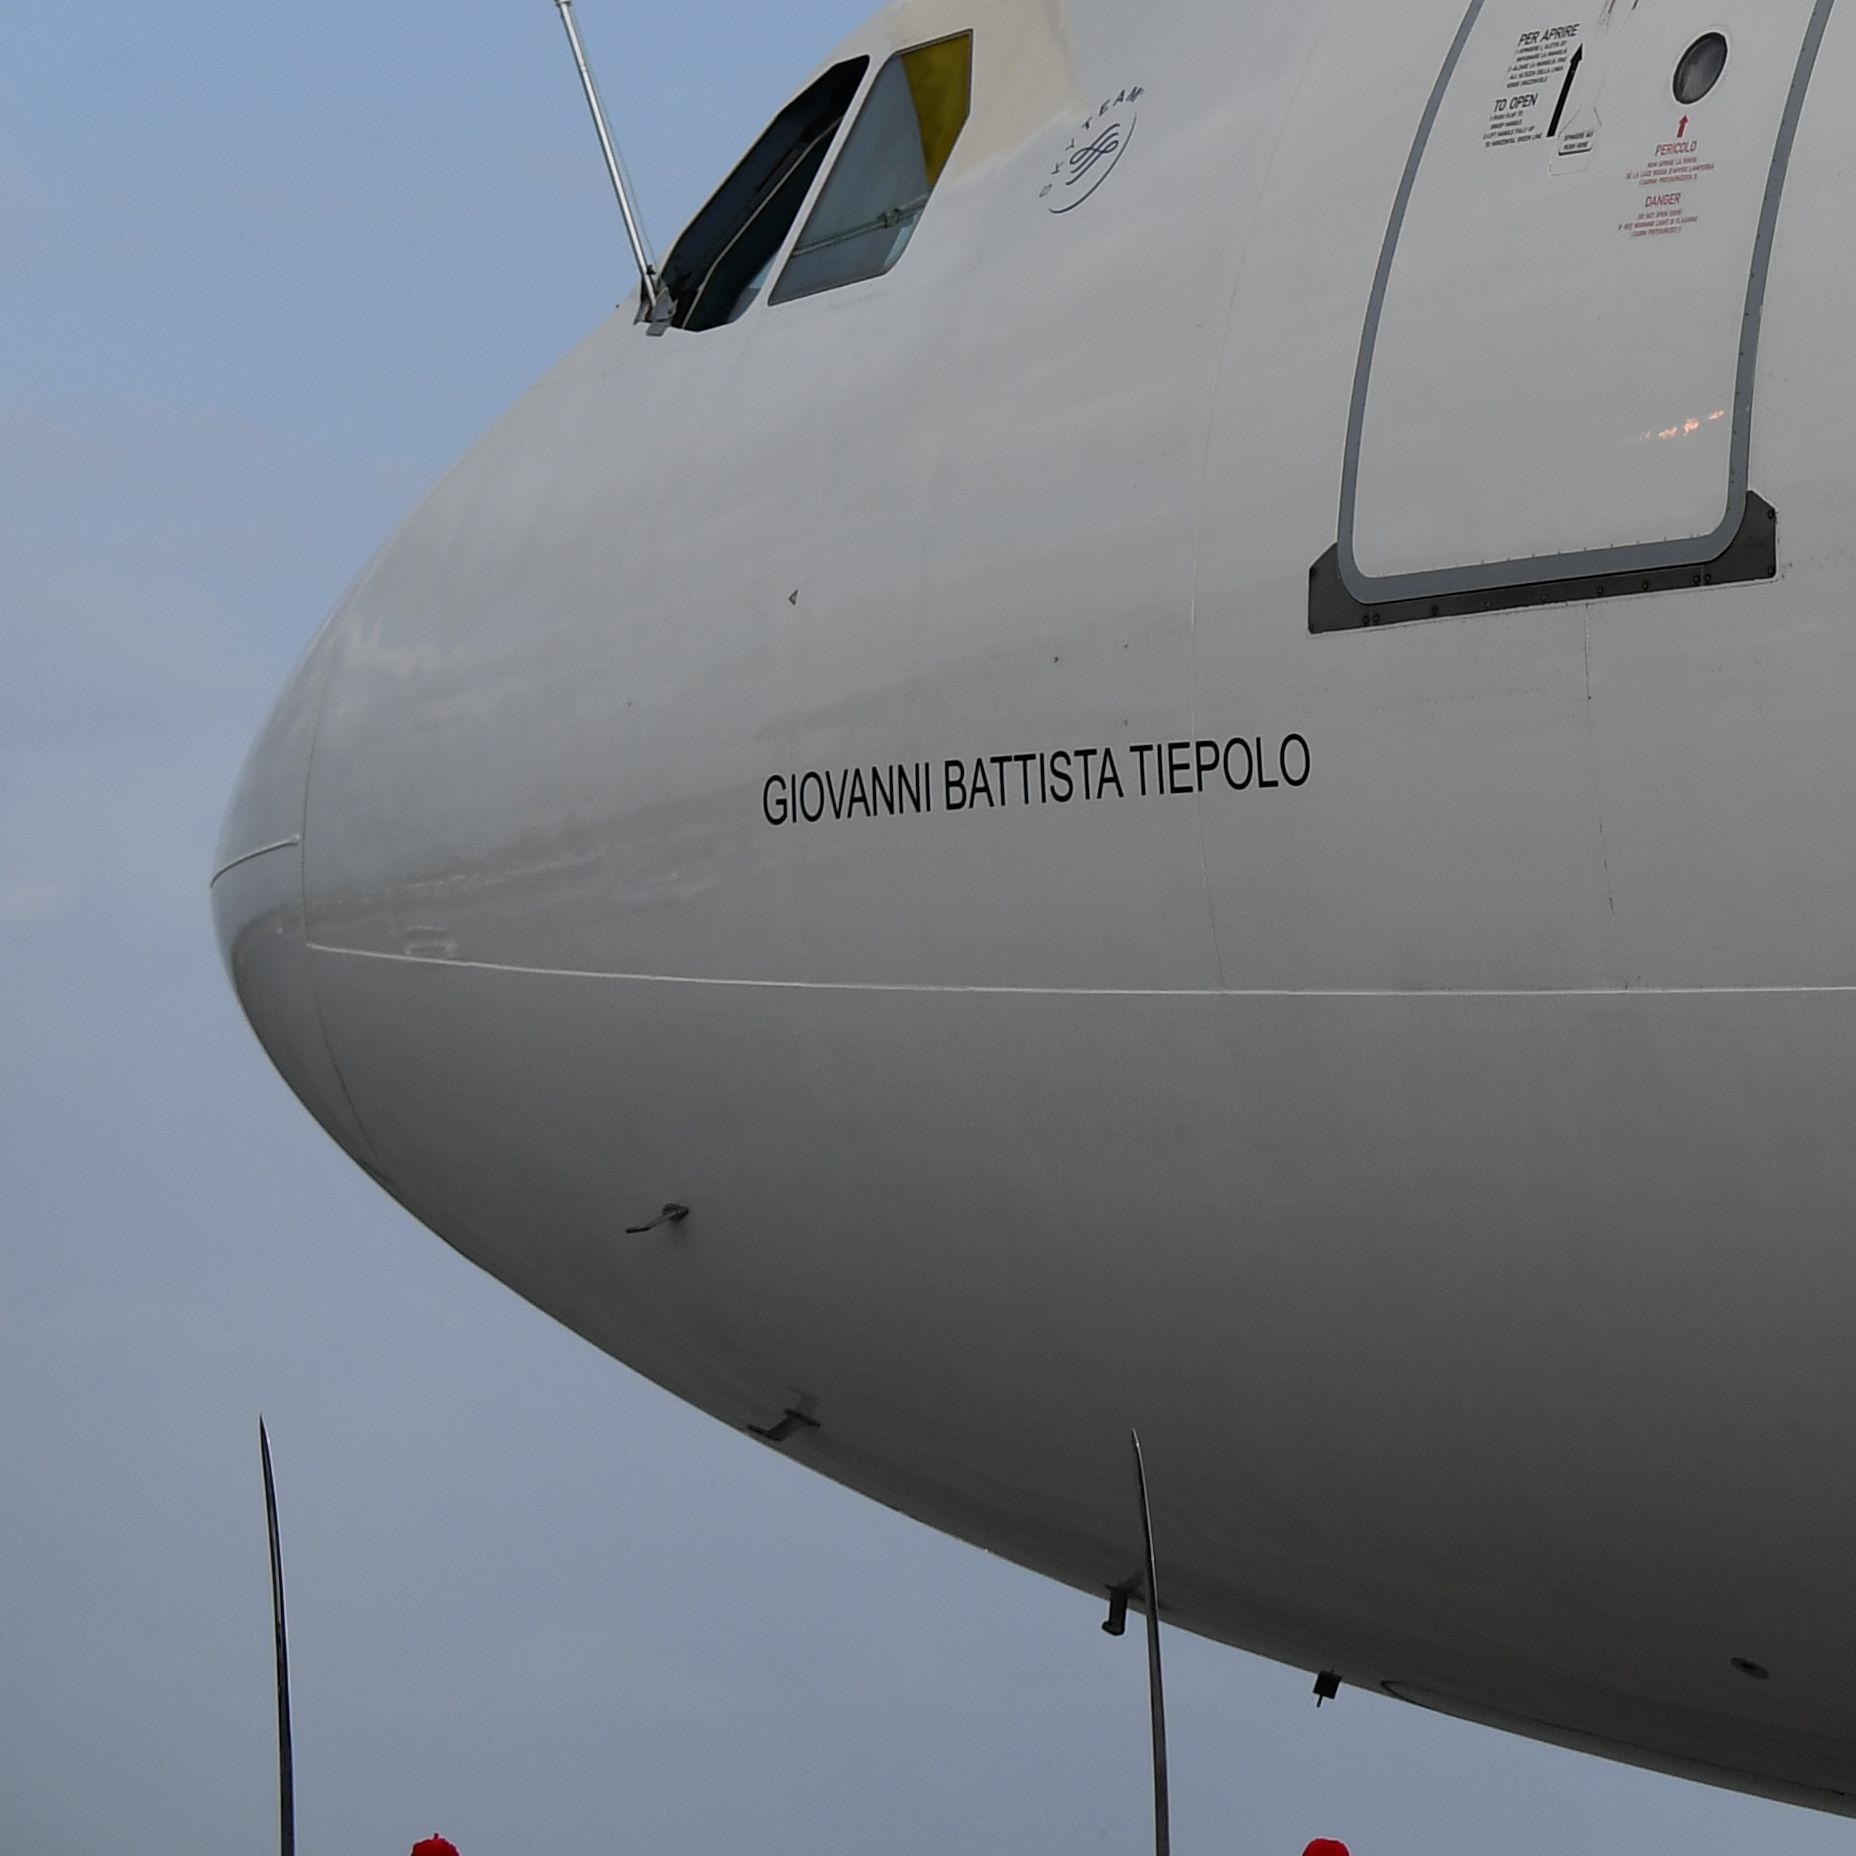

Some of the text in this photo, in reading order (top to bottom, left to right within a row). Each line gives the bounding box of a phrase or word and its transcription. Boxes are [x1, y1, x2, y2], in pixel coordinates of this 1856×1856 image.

[1517, 23, 1581, 46] PER APRIRE
[1493, 92, 1539, 113] TO OPEN
[1654, 140, 1698, 156] PERICOLO
[1645, 192, 1682, 208] DANGER
[762, 732, 1311, 828] GIOVANNI BATTISTA TIEPOLO
